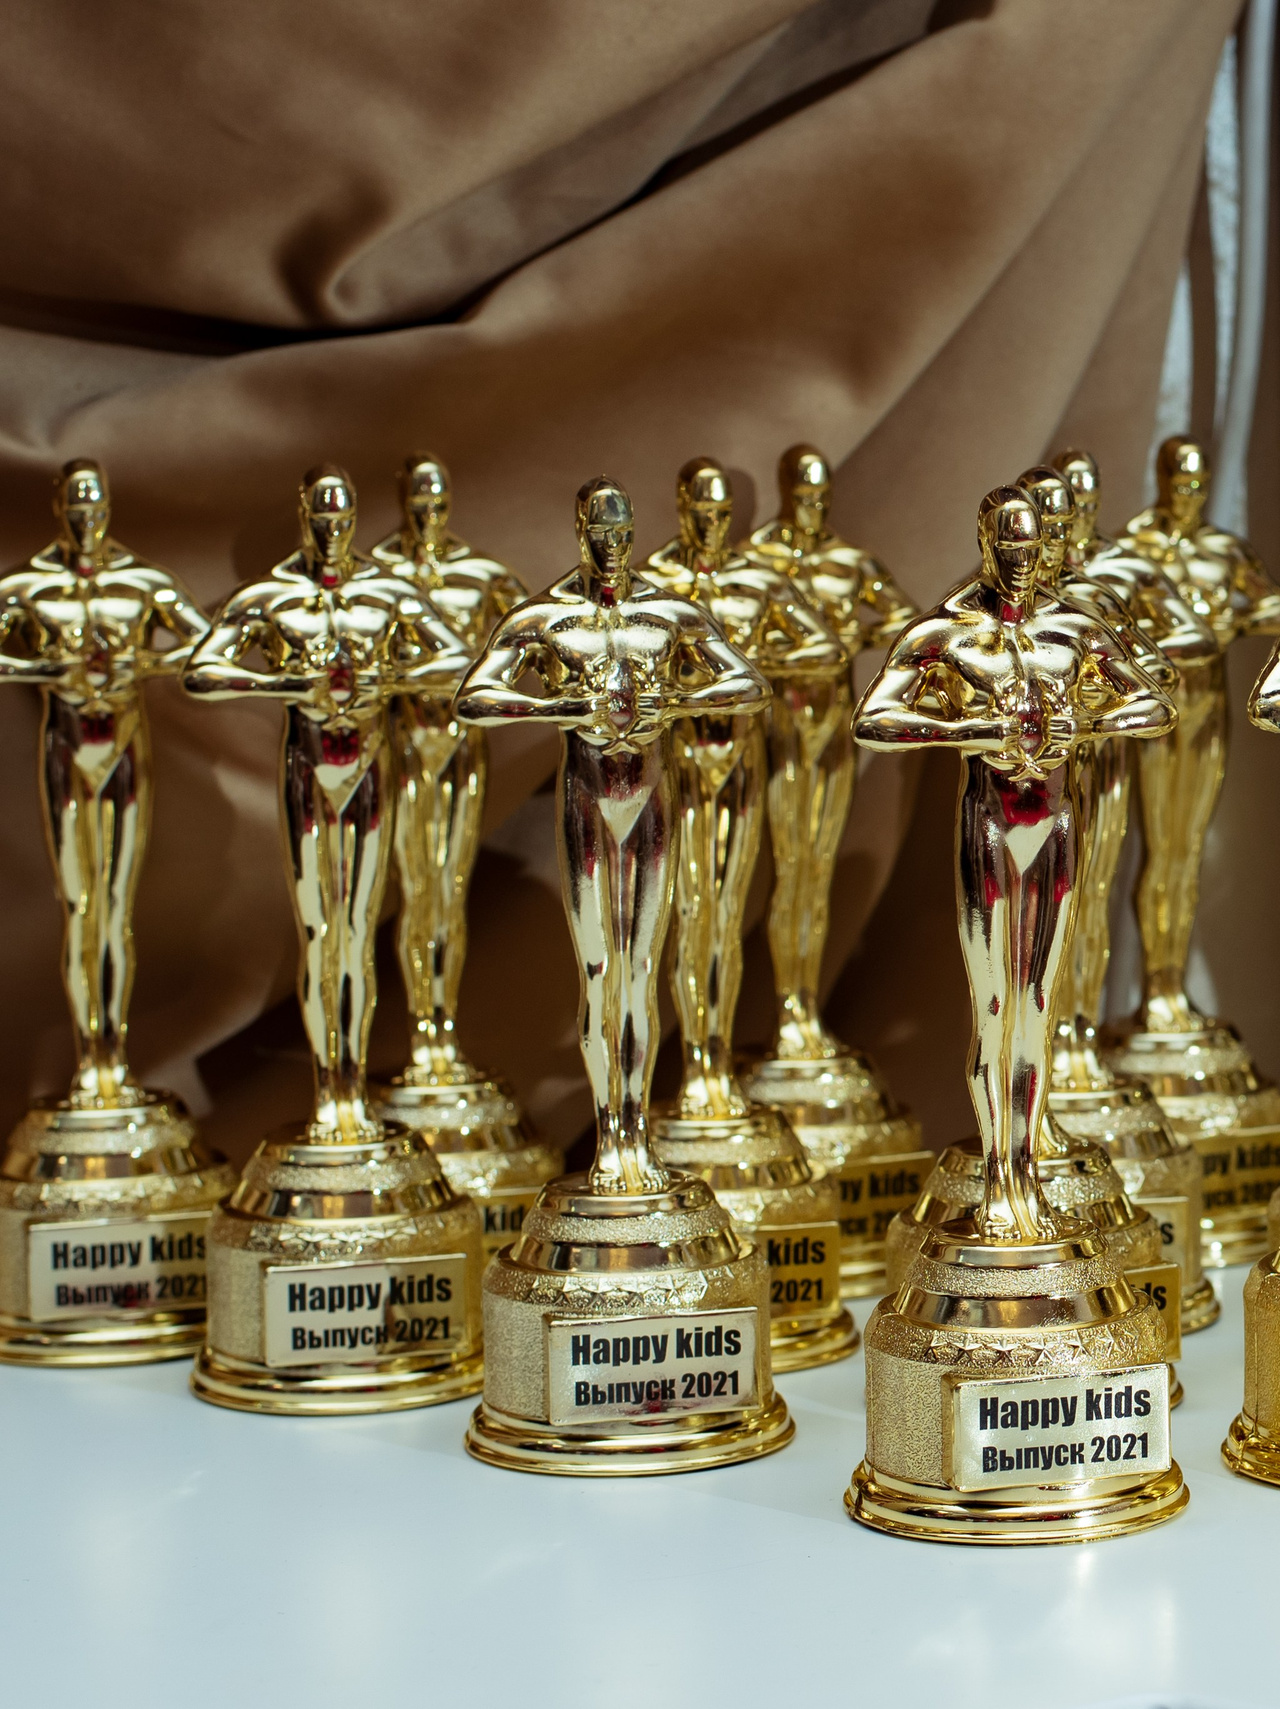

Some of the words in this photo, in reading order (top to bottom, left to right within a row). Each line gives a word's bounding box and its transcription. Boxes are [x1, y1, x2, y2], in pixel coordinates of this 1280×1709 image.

[484, 1205, 525, 1234] kid
[52, 1240, 142, 1270] Happy
[768, 1237, 826, 1266] kids
[55, 1281, 150, 1308] Выпуск
[288, 1282, 382, 1313] Happy
[389, 1274, 452, 1305] kids
[771, 1277, 823, 1304] 2021
[291, 1323, 389, 1350] Выпуск
[395, 1317, 450, 1343] 2021
[571, 1333, 669, 1367] Happy
[676, 1325, 742, 1359] kids
[575, 1378, 676, 1406] Выпуск
[681, 1370, 740, 1399] 2021
[979, 1396, 1078, 1431] Happy
[1085, 1385, 1151, 1421] kids
[982, 1442, 1085, 1473] Выпуск
[1090, 1432, 1149, 1463] 2021
